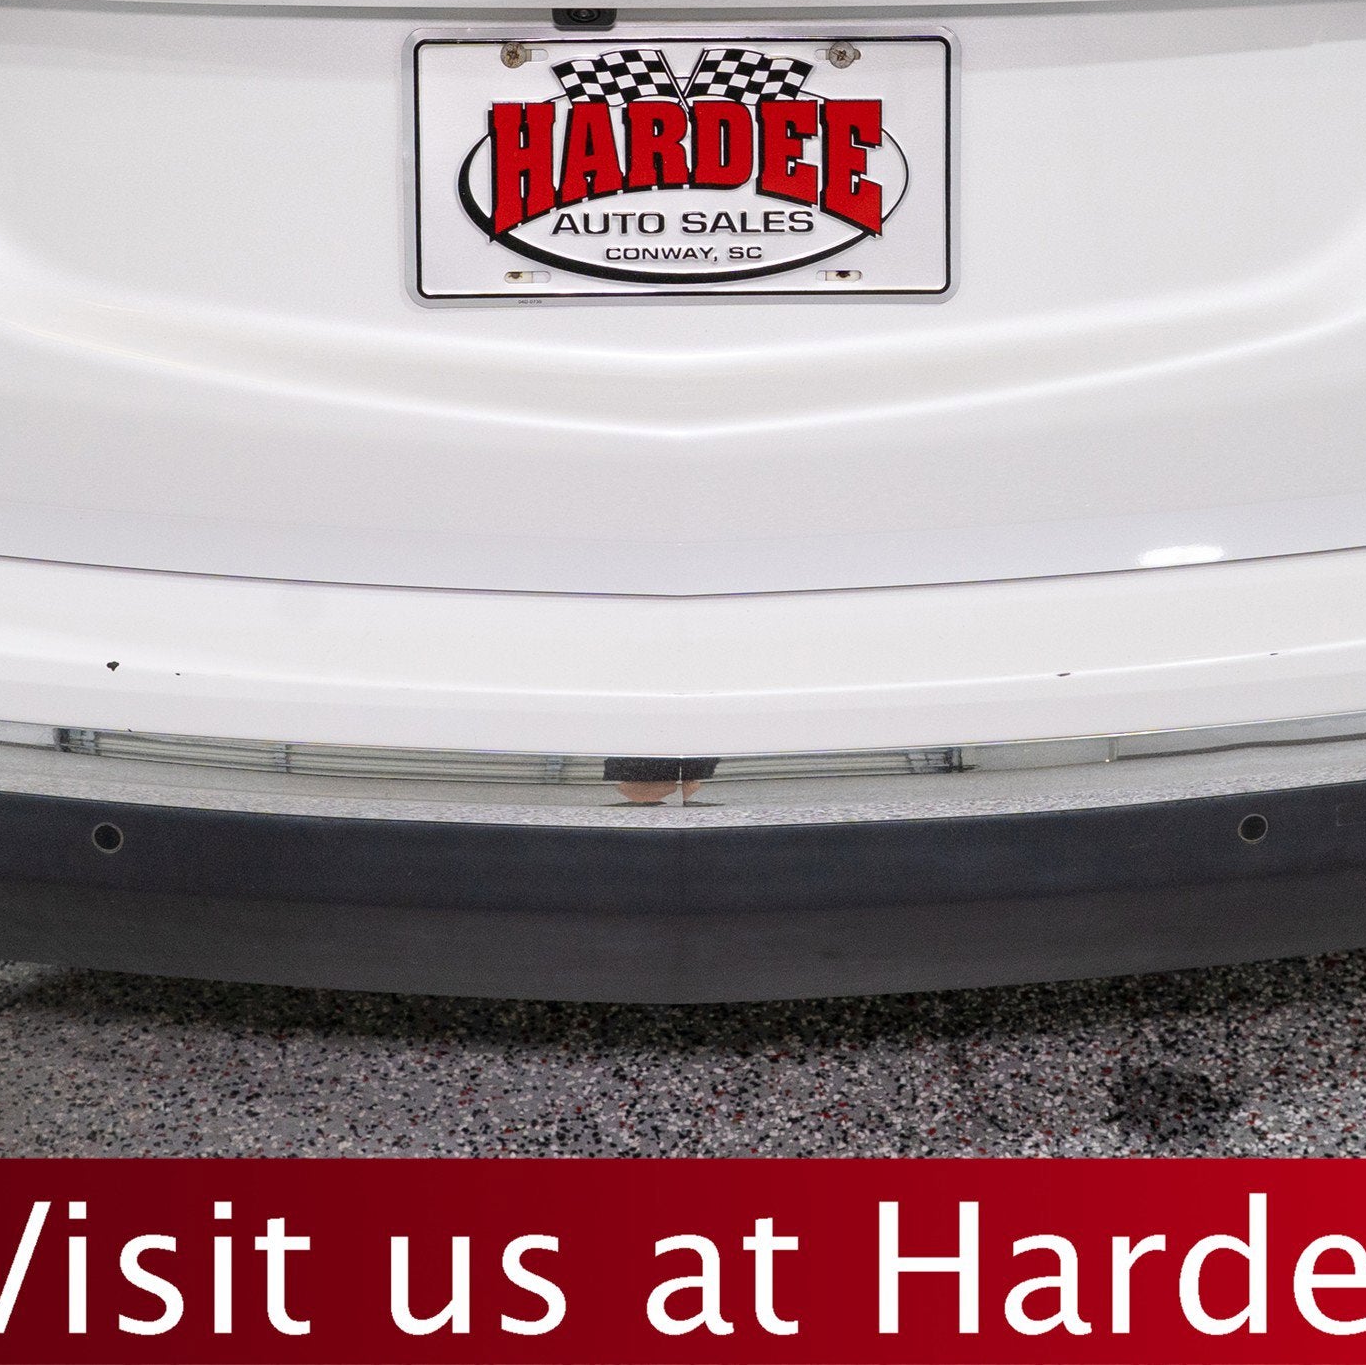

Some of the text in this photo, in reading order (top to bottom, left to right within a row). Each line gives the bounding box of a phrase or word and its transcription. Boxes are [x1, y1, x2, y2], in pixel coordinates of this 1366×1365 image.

[489, 99, 883, 239] HARDEE
[552, 210, 815, 236] AUTO SALES
[605, 246, 763, 262] CONWAY, SC
